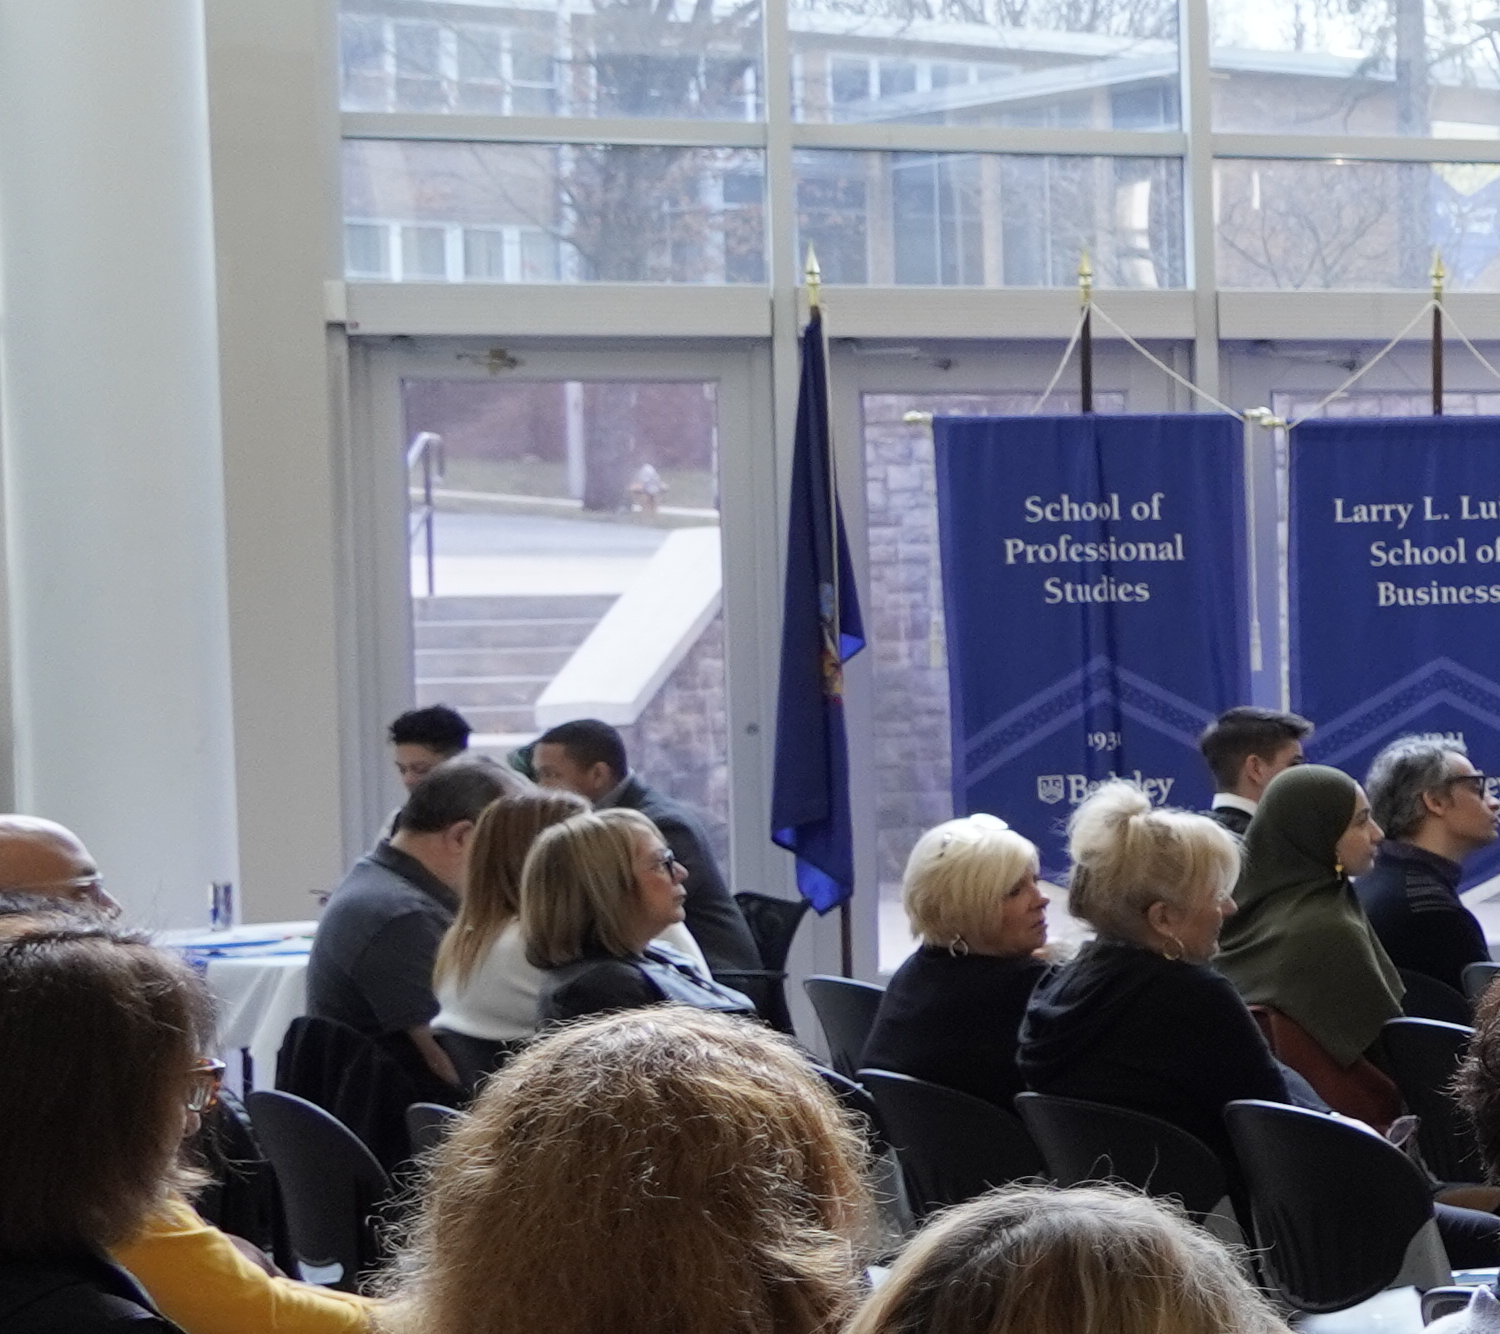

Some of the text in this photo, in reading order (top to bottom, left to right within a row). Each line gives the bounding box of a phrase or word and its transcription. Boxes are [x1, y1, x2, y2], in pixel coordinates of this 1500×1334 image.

[1025, 492, 1165, 523] School of
[1334, 497, 1414, 529] Larry
[1423, 496, 1450, 521] L.
[1004, 533, 1185, 565] Professional
[1370, 537, 1467, 567] School
[1044, 575, 1151, 604] Studies
[1087, 731, 1122, 751] 1931
[1066, 770, 1175, 805] Beley
